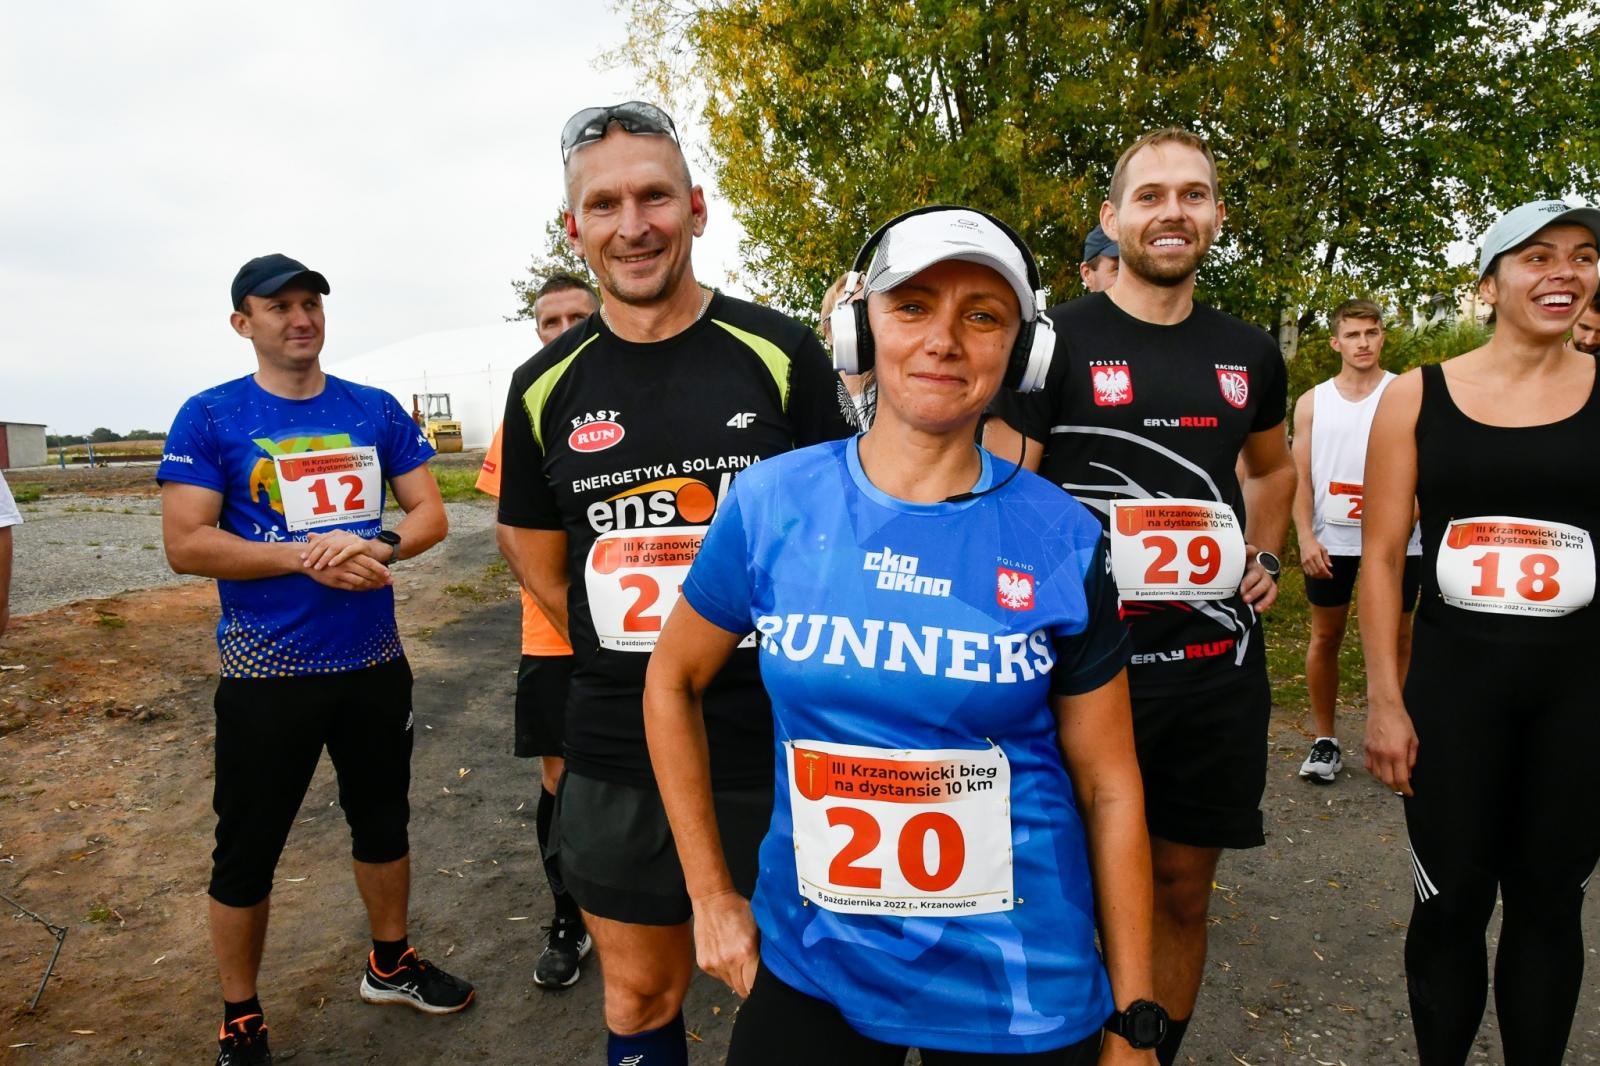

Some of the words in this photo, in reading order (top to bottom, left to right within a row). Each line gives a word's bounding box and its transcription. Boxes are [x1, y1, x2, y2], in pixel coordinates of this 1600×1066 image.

[571, 410, 621, 430] EASY
[726, 412, 757, 428] 4F
[577, 428, 616, 445] RUN
[162, 452, 194, 464] ybnik
[312, 454, 358, 466] Krzanowicki
[317, 462, 354, 473] dystansie
[572, 463, 676, 493] ENERGETYKA
[682, 455, 762, 473] SOLARNA
[308, 474, 364, 516] 12
[587, 472, 739, 533] ensol
[1158, 510, 1213, 518] Krzanowicki
[1215, 512, 1232, 521] bieg
[1164, 519, 1208, 528] dystansie
[1489, 526, 1557, 538] Krzanowicki
[1560, 532, 1584, 543] bieg
[1494, 536, 1548, 546] dystansie
[1565, 542, 1583, 550] km
[624, 542, 634, 552] III
[637, 538, 704, 551] Krzanowic
[996, 556, 1034, 571] POLAND
[1142, 536, 1222, 584] 29
[1471, 552, 1560, 602] 18
[619, 574, 683, 632] 2
[756, 614, 1054, 684] RUNNERS
[832, 762, 846, 775] III
[851, 763, 954, 780] Krzanowicki
[960, 764, 997, 778] bieg
[834, 780, 854, 793] na
[859, 780, 941, 797] dystansie
[945, 781, 961, 795] 10
[967, 778, 993, 792] km
[826, 806, 966, 892] 20
[920, 900, 977, 909] Krzanowice
